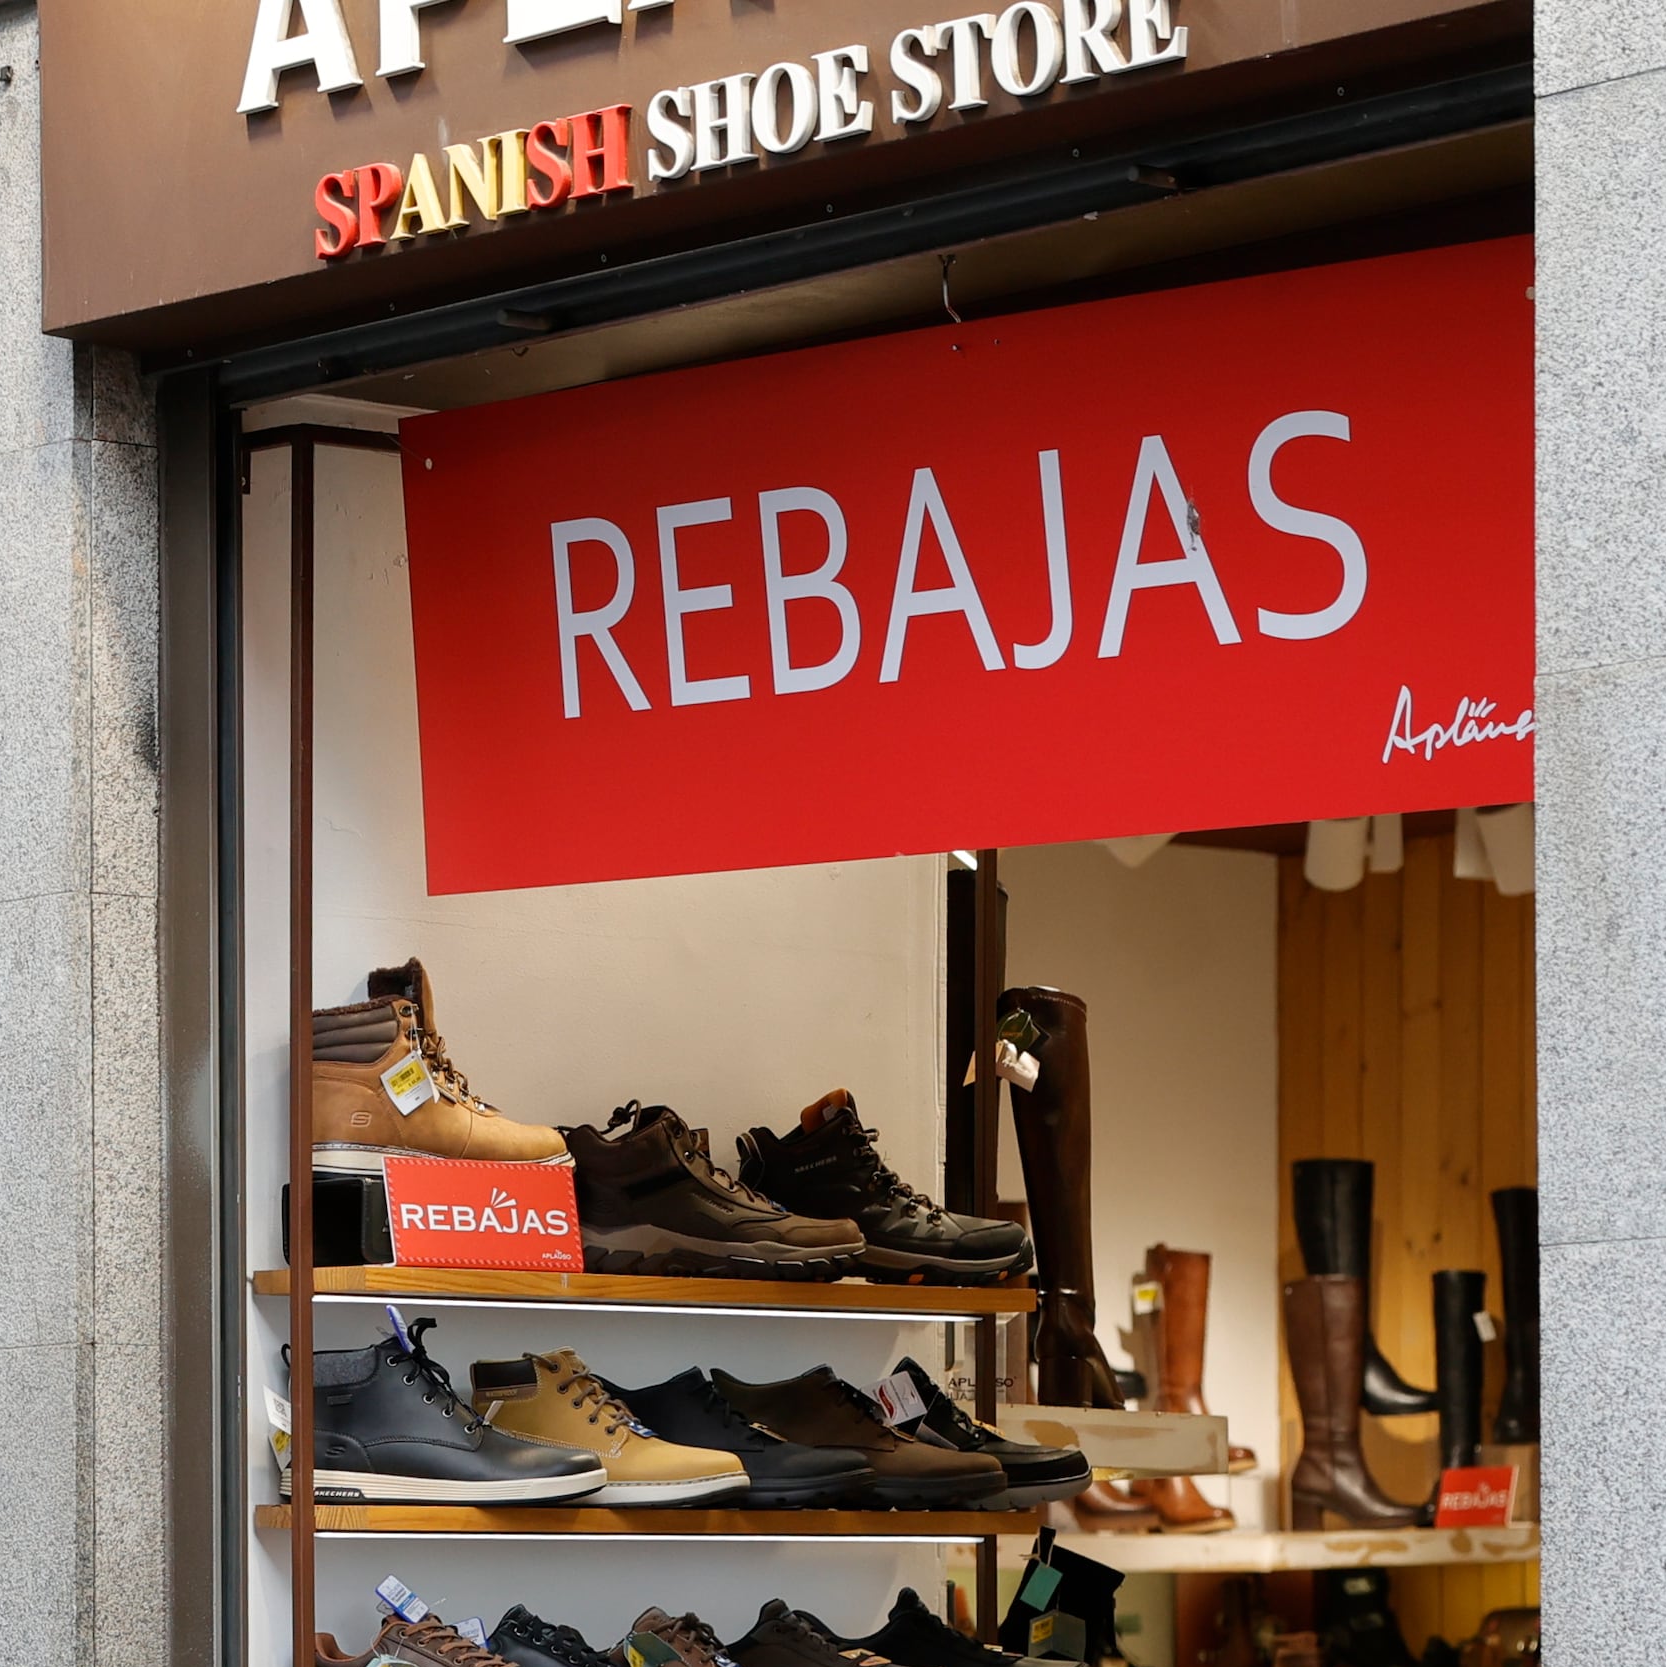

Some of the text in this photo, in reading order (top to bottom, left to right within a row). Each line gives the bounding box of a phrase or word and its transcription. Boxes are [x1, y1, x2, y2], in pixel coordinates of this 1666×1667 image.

[314, 102, 634, 262] SPANISH
[647, 44, 874, 183] SHOE
[889, 0, 1188, 124] STORE
[549, 409, 1370, 720] REBAJAS
[399, 1202, 570, 1236] REBAJAS
[948, 1377, 1014, 1388] APLSO
[314, 1490, 361, 1498] SKECHERS
